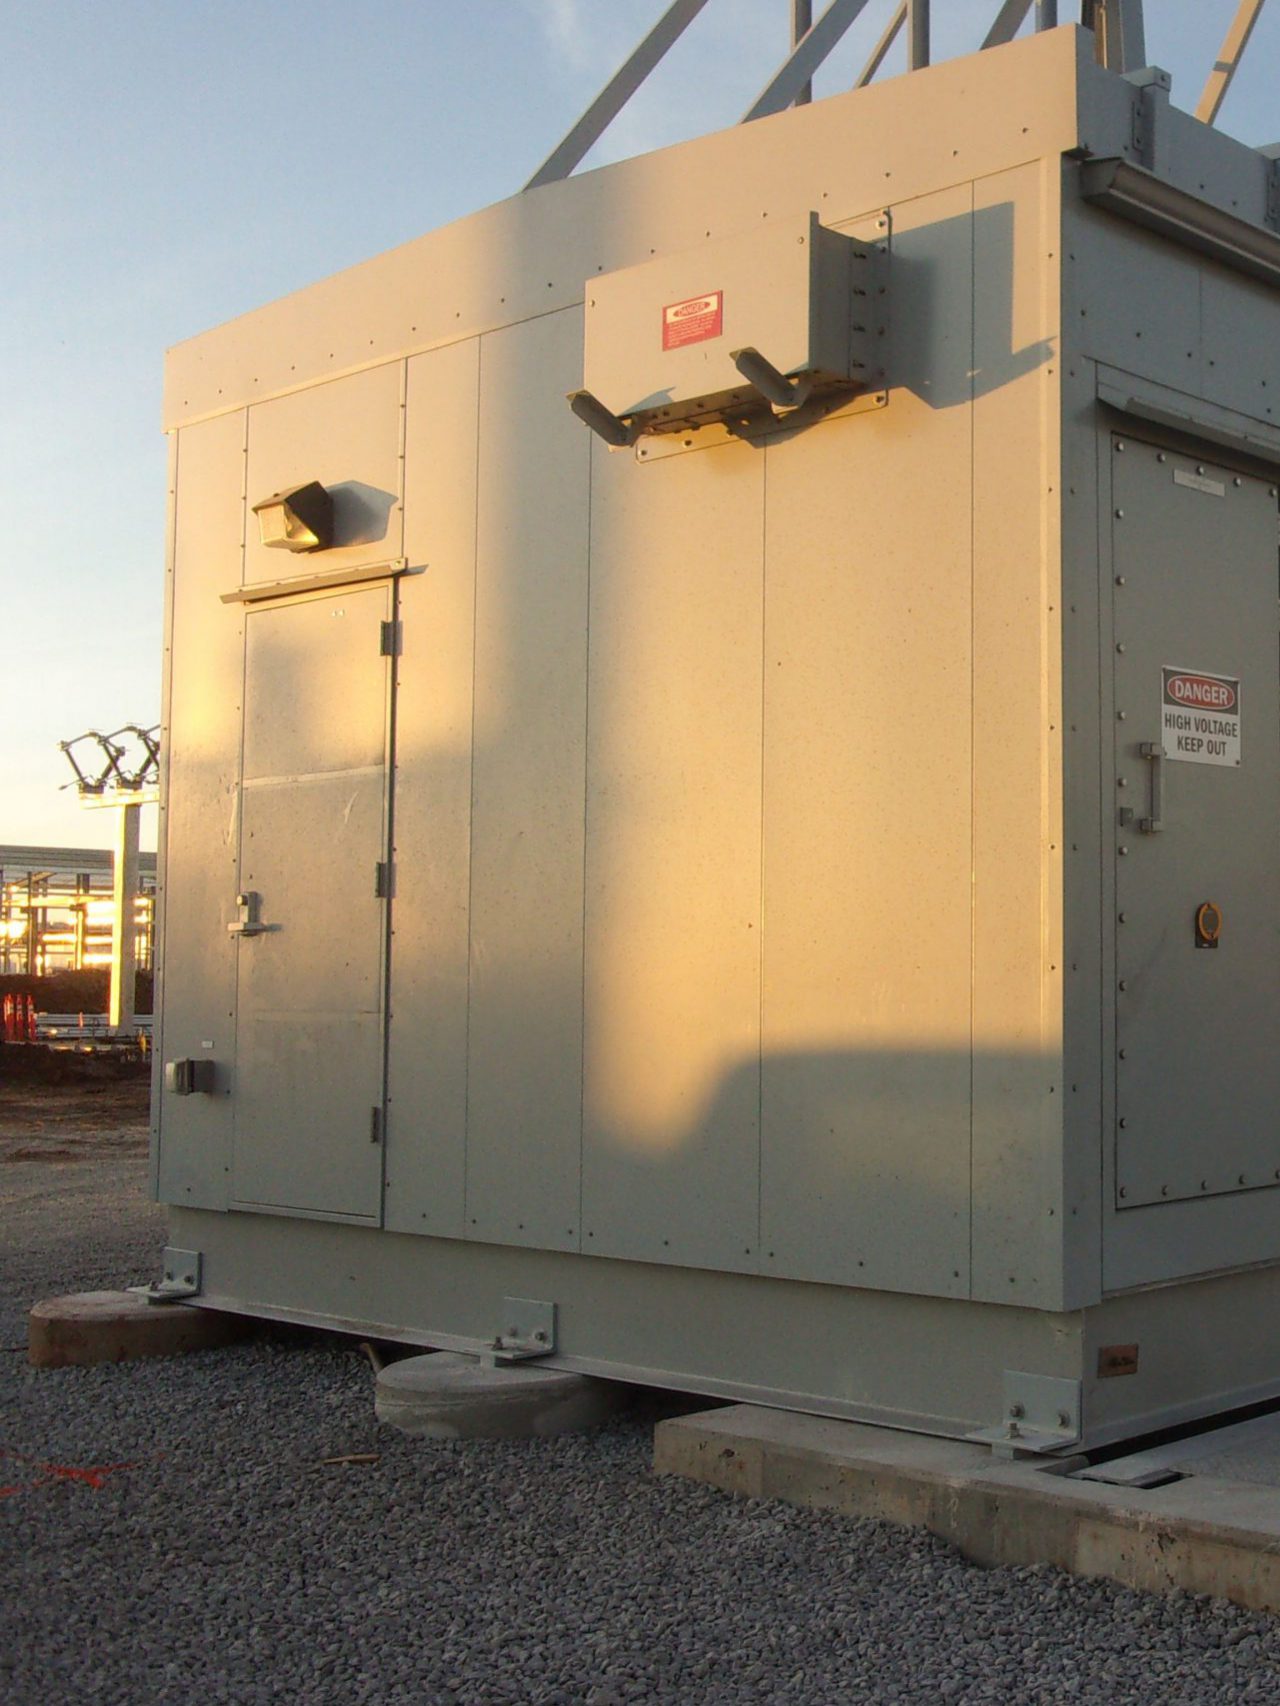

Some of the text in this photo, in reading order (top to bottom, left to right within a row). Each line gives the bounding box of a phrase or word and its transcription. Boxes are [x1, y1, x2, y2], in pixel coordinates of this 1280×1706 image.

[1175, 680, 1228, 705] DANGER
[1165, 712, 1238, 738] HIGH VOLTAGE
[1177, 735, 1227, 756] KEEP OUT
